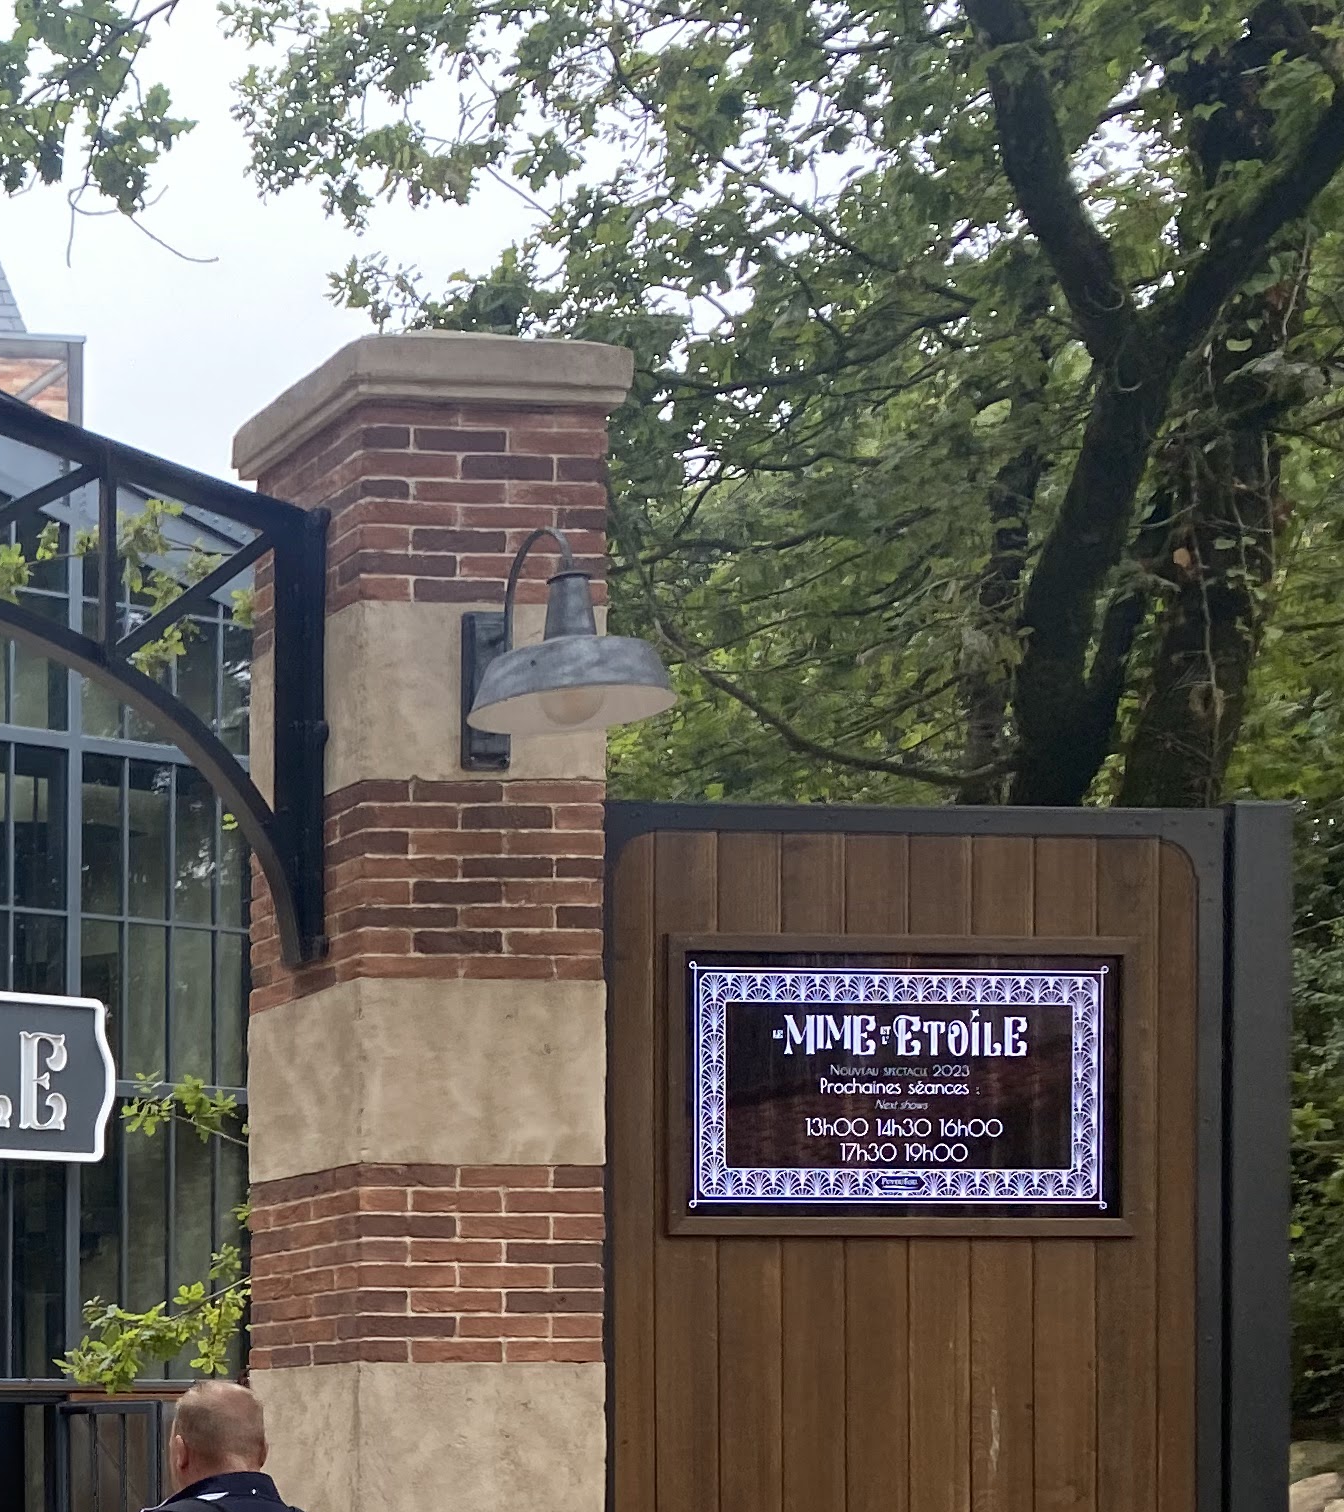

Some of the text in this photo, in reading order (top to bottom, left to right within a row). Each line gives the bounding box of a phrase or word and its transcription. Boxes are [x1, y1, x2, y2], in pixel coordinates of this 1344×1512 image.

[772, 1029, 784, 1040] LE
[932, 1064, 971, 1077] 2023
[820, 1078, 902, 1095] Prochaines
[908, 1080, 970, 1095] séances
[875, 1099, 929, 1110] Next shows
[804, 1117, 1004, 1138] 13h00 14h30 16h00
[839, 1142, 969, 1162] 17h30 19h00
